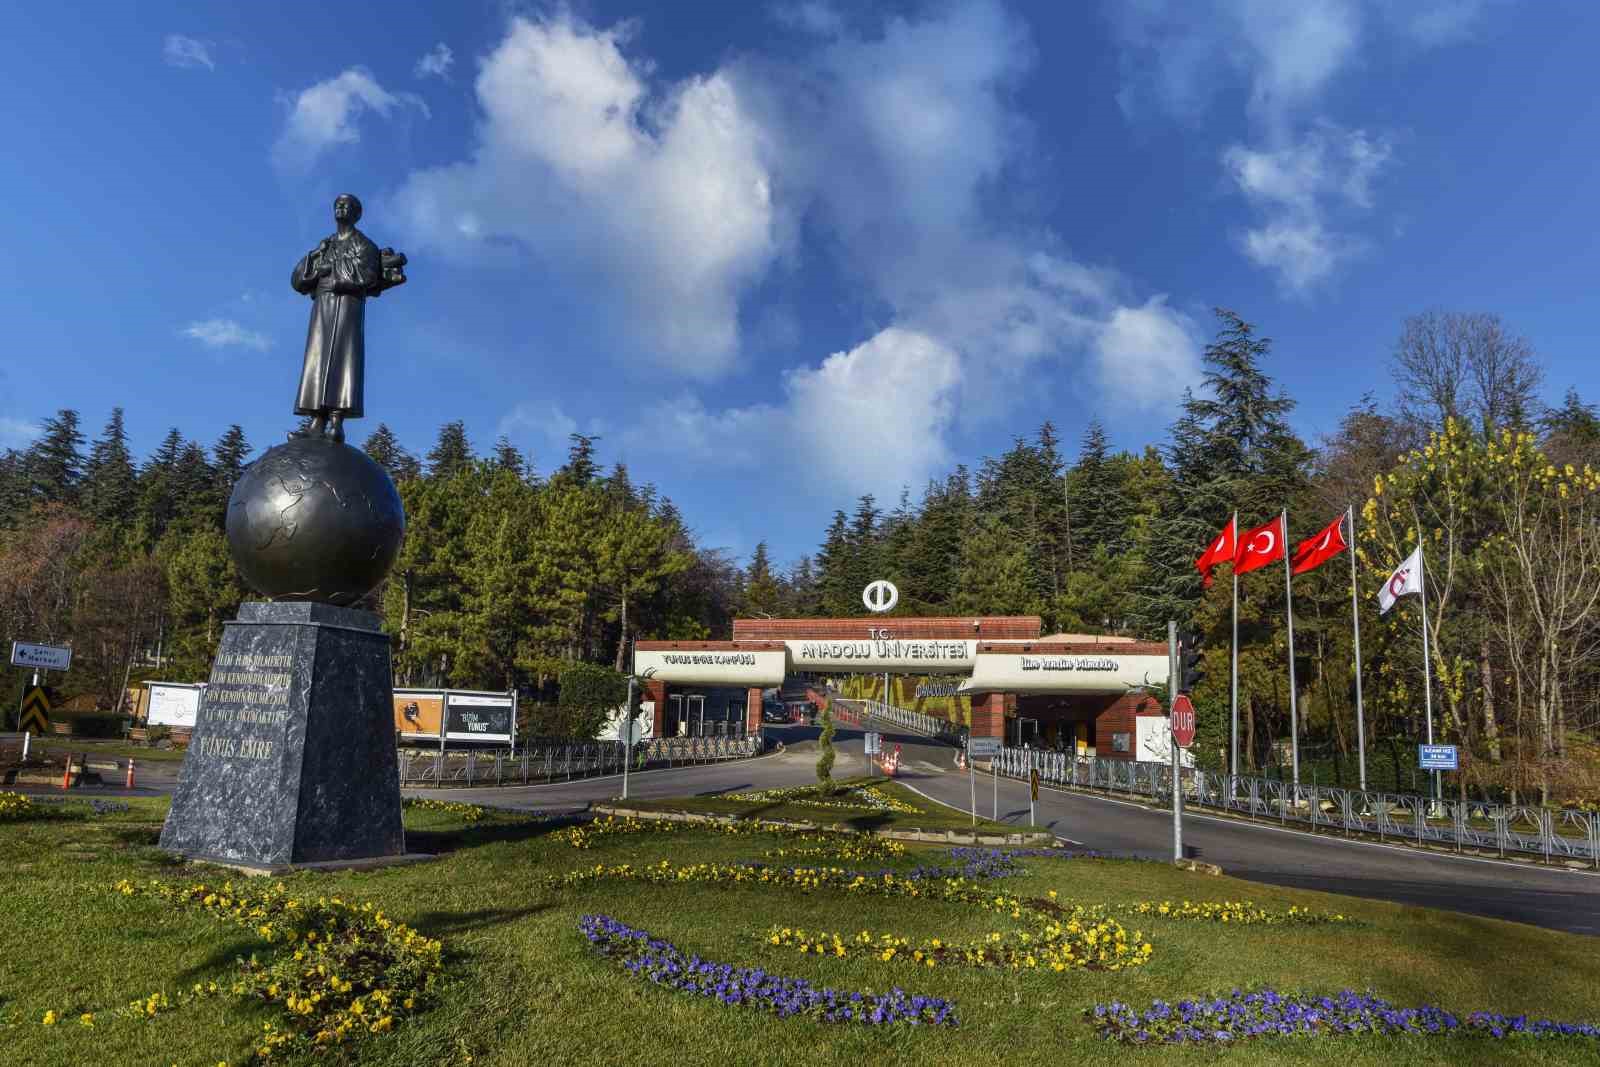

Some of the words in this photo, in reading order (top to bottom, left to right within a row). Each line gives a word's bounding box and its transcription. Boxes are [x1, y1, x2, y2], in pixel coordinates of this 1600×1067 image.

[801, 643, 871, 659] ANADOLU
[876, 641, 968, 659] ÜNİVERSİTESİ
[663, 654, 691, 665] YUNUS
[692, 655, 713, 665] EMRE
[714, 653, 756, 666] KAMPÜSÜ
[1173, 711, 1193, 730] DUR
[200, 735, 235, 758] YUNUS
[240, 739, 273, 760] EMRE
